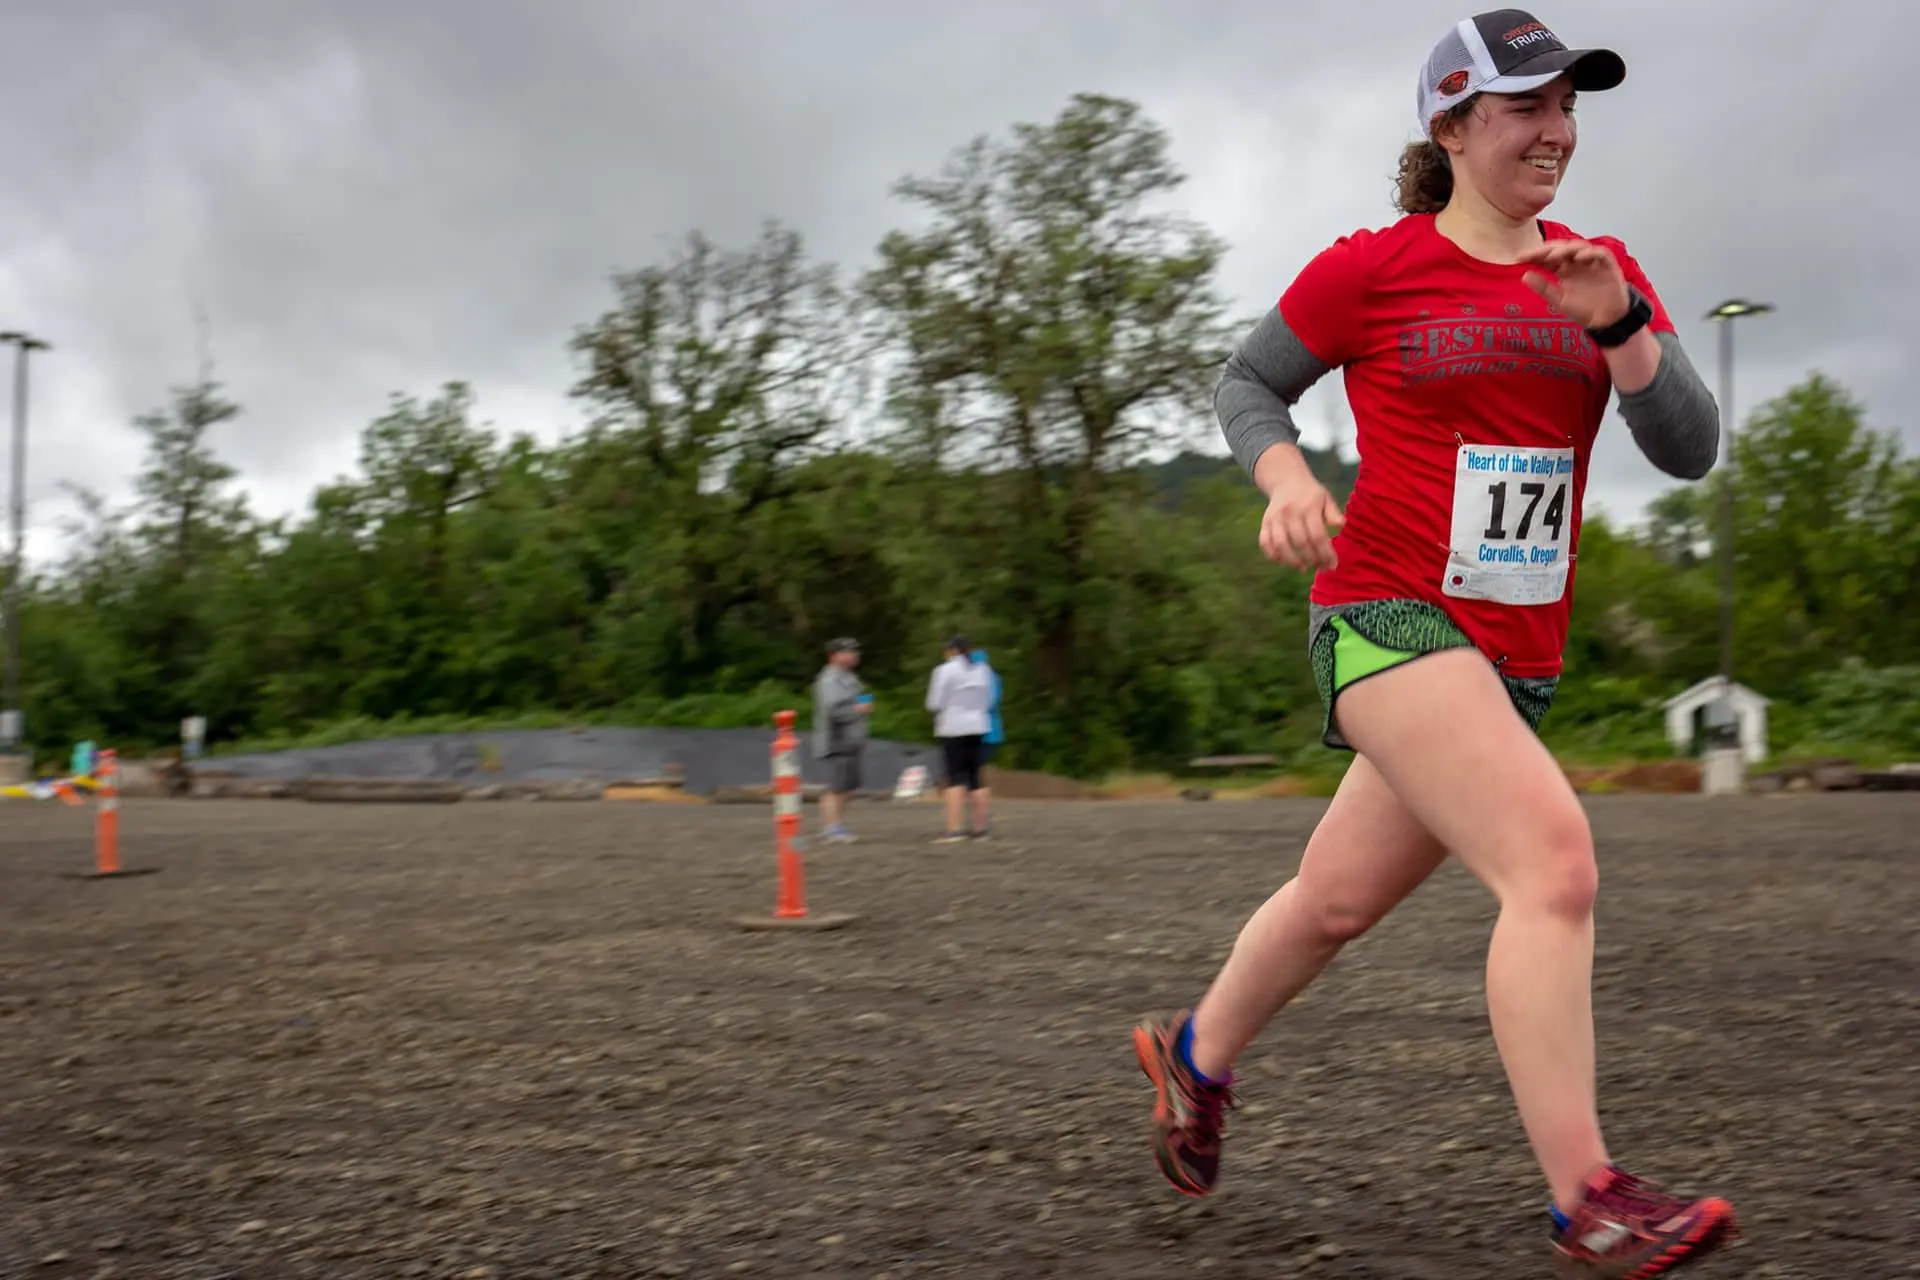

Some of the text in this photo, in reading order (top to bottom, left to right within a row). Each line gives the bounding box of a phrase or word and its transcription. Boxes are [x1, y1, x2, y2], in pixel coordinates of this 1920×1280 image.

[1507, 30, 1556, 50] TRIATH
[1399, 325, 1502, 364] BEST
[1528, 326, 1592, 359] WES
[1468, 452, 1495, 471] Heart
[1498, 453, 1511, 472] of
[1512, 454, 1528, 473] the
[1530, 455, 1554, 478] Valley
[1484, 481, 1566, 541] 174
[1478, 543, 1528, 567] Corvallis,
